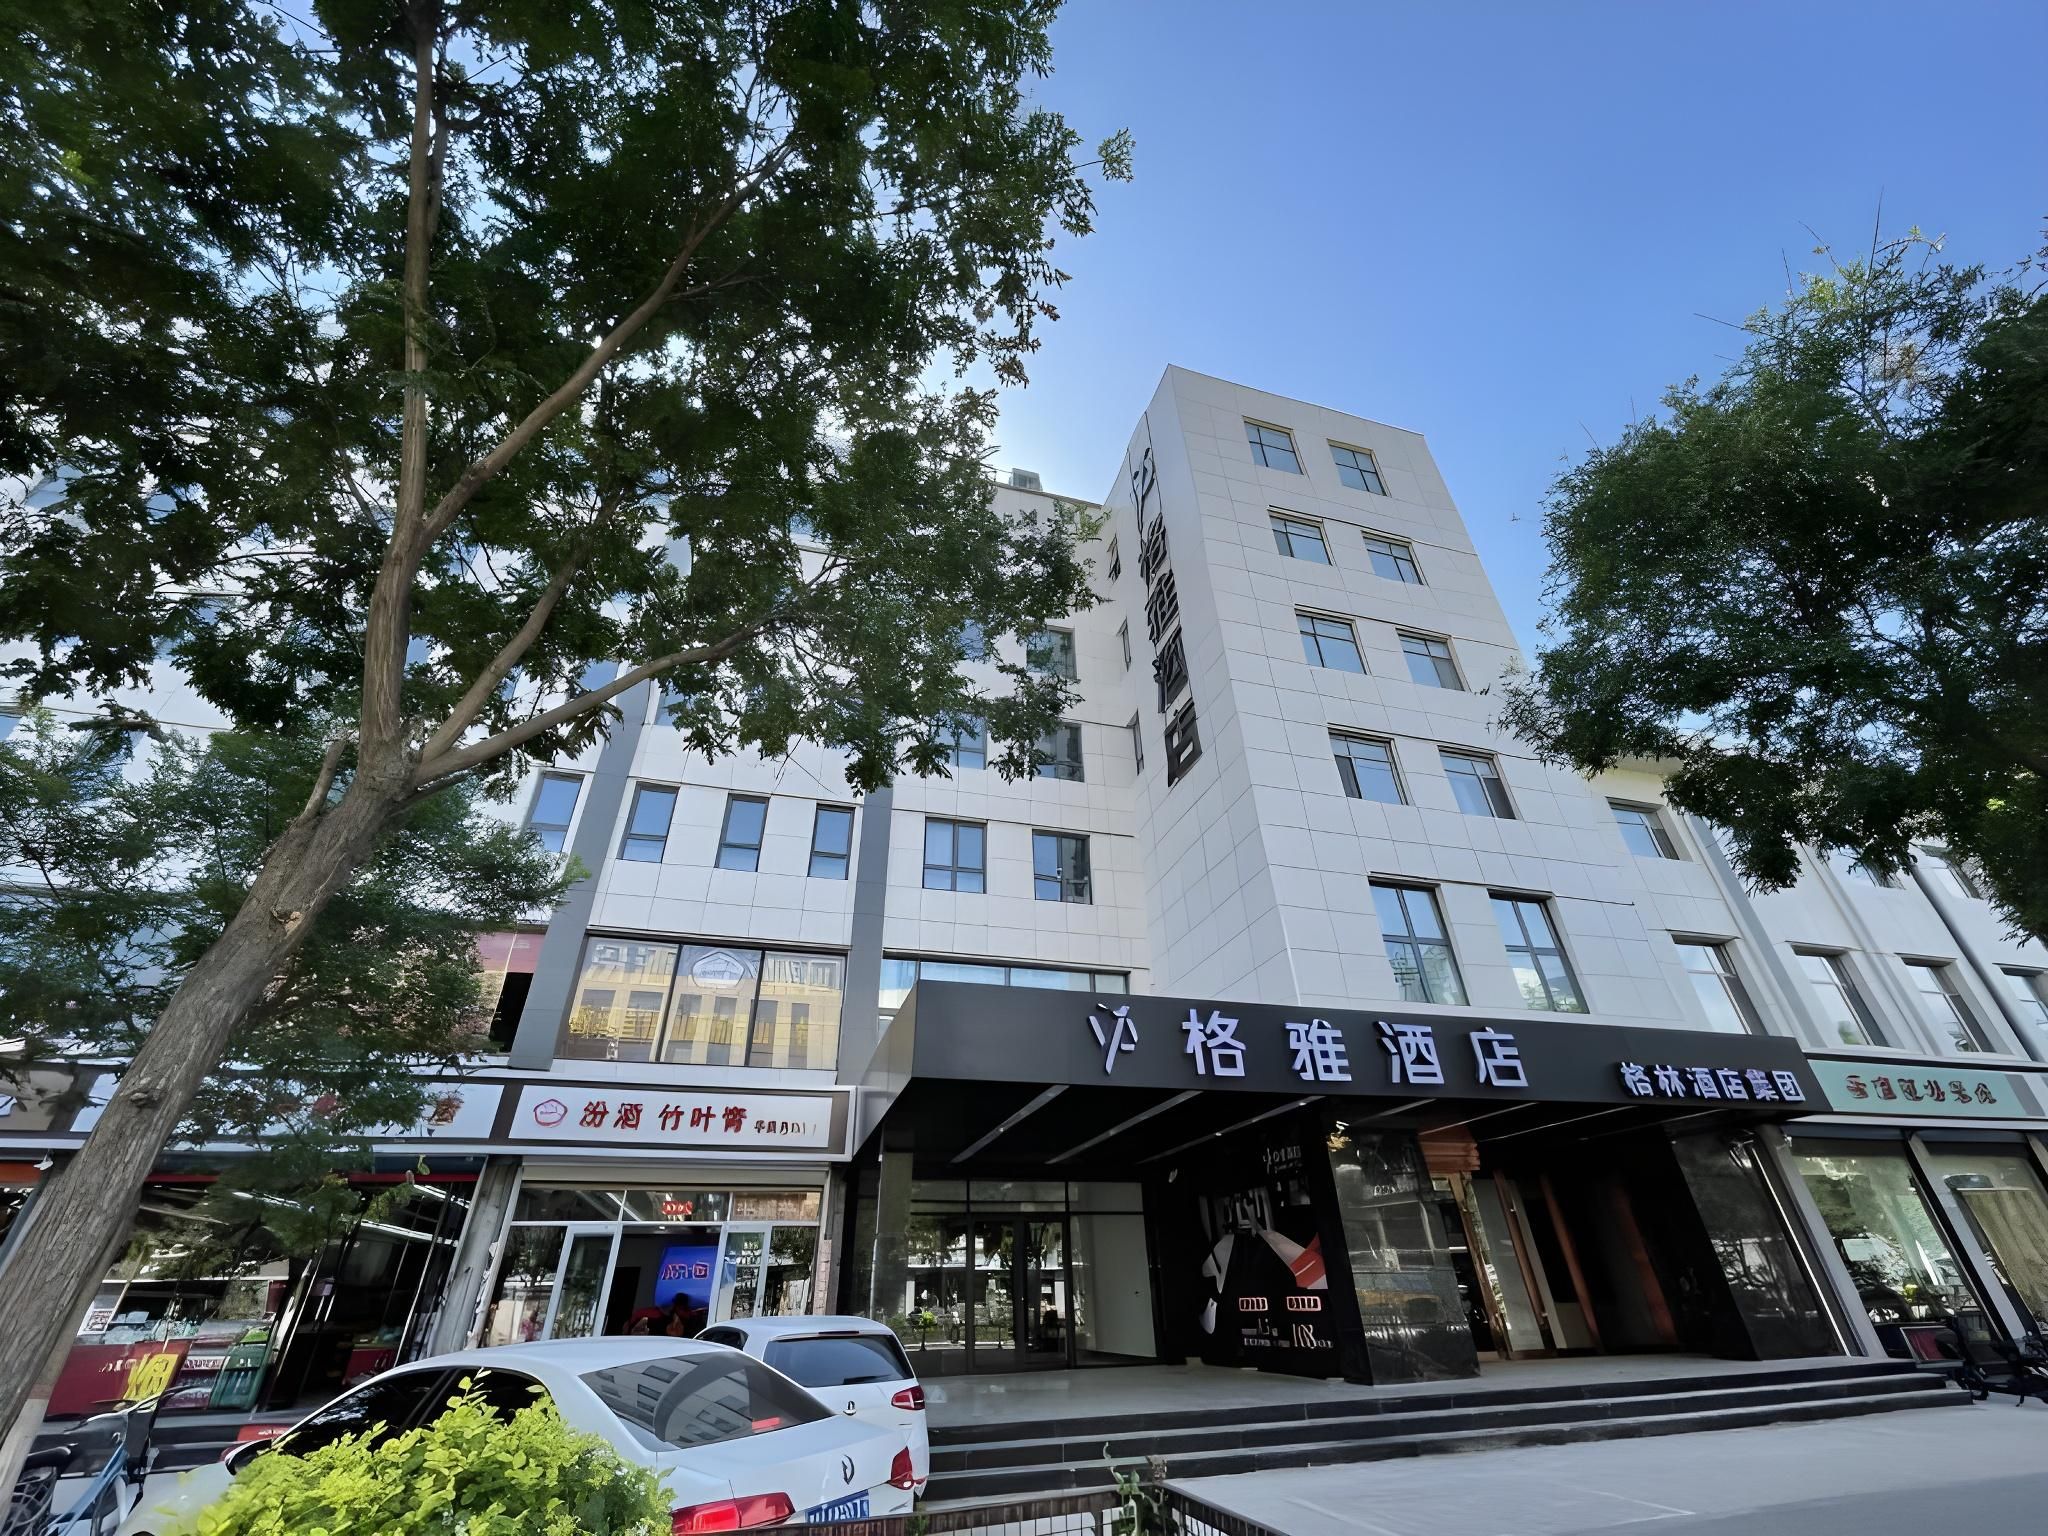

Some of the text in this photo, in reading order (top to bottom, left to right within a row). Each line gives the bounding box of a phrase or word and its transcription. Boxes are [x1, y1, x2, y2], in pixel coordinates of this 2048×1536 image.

[1181, 1008, 1529, 1087] 格雅酒店
[1619, 1062, 1806, 1102] 格林酒店集团
[578, 1100, 643, 1131] 汾酒
